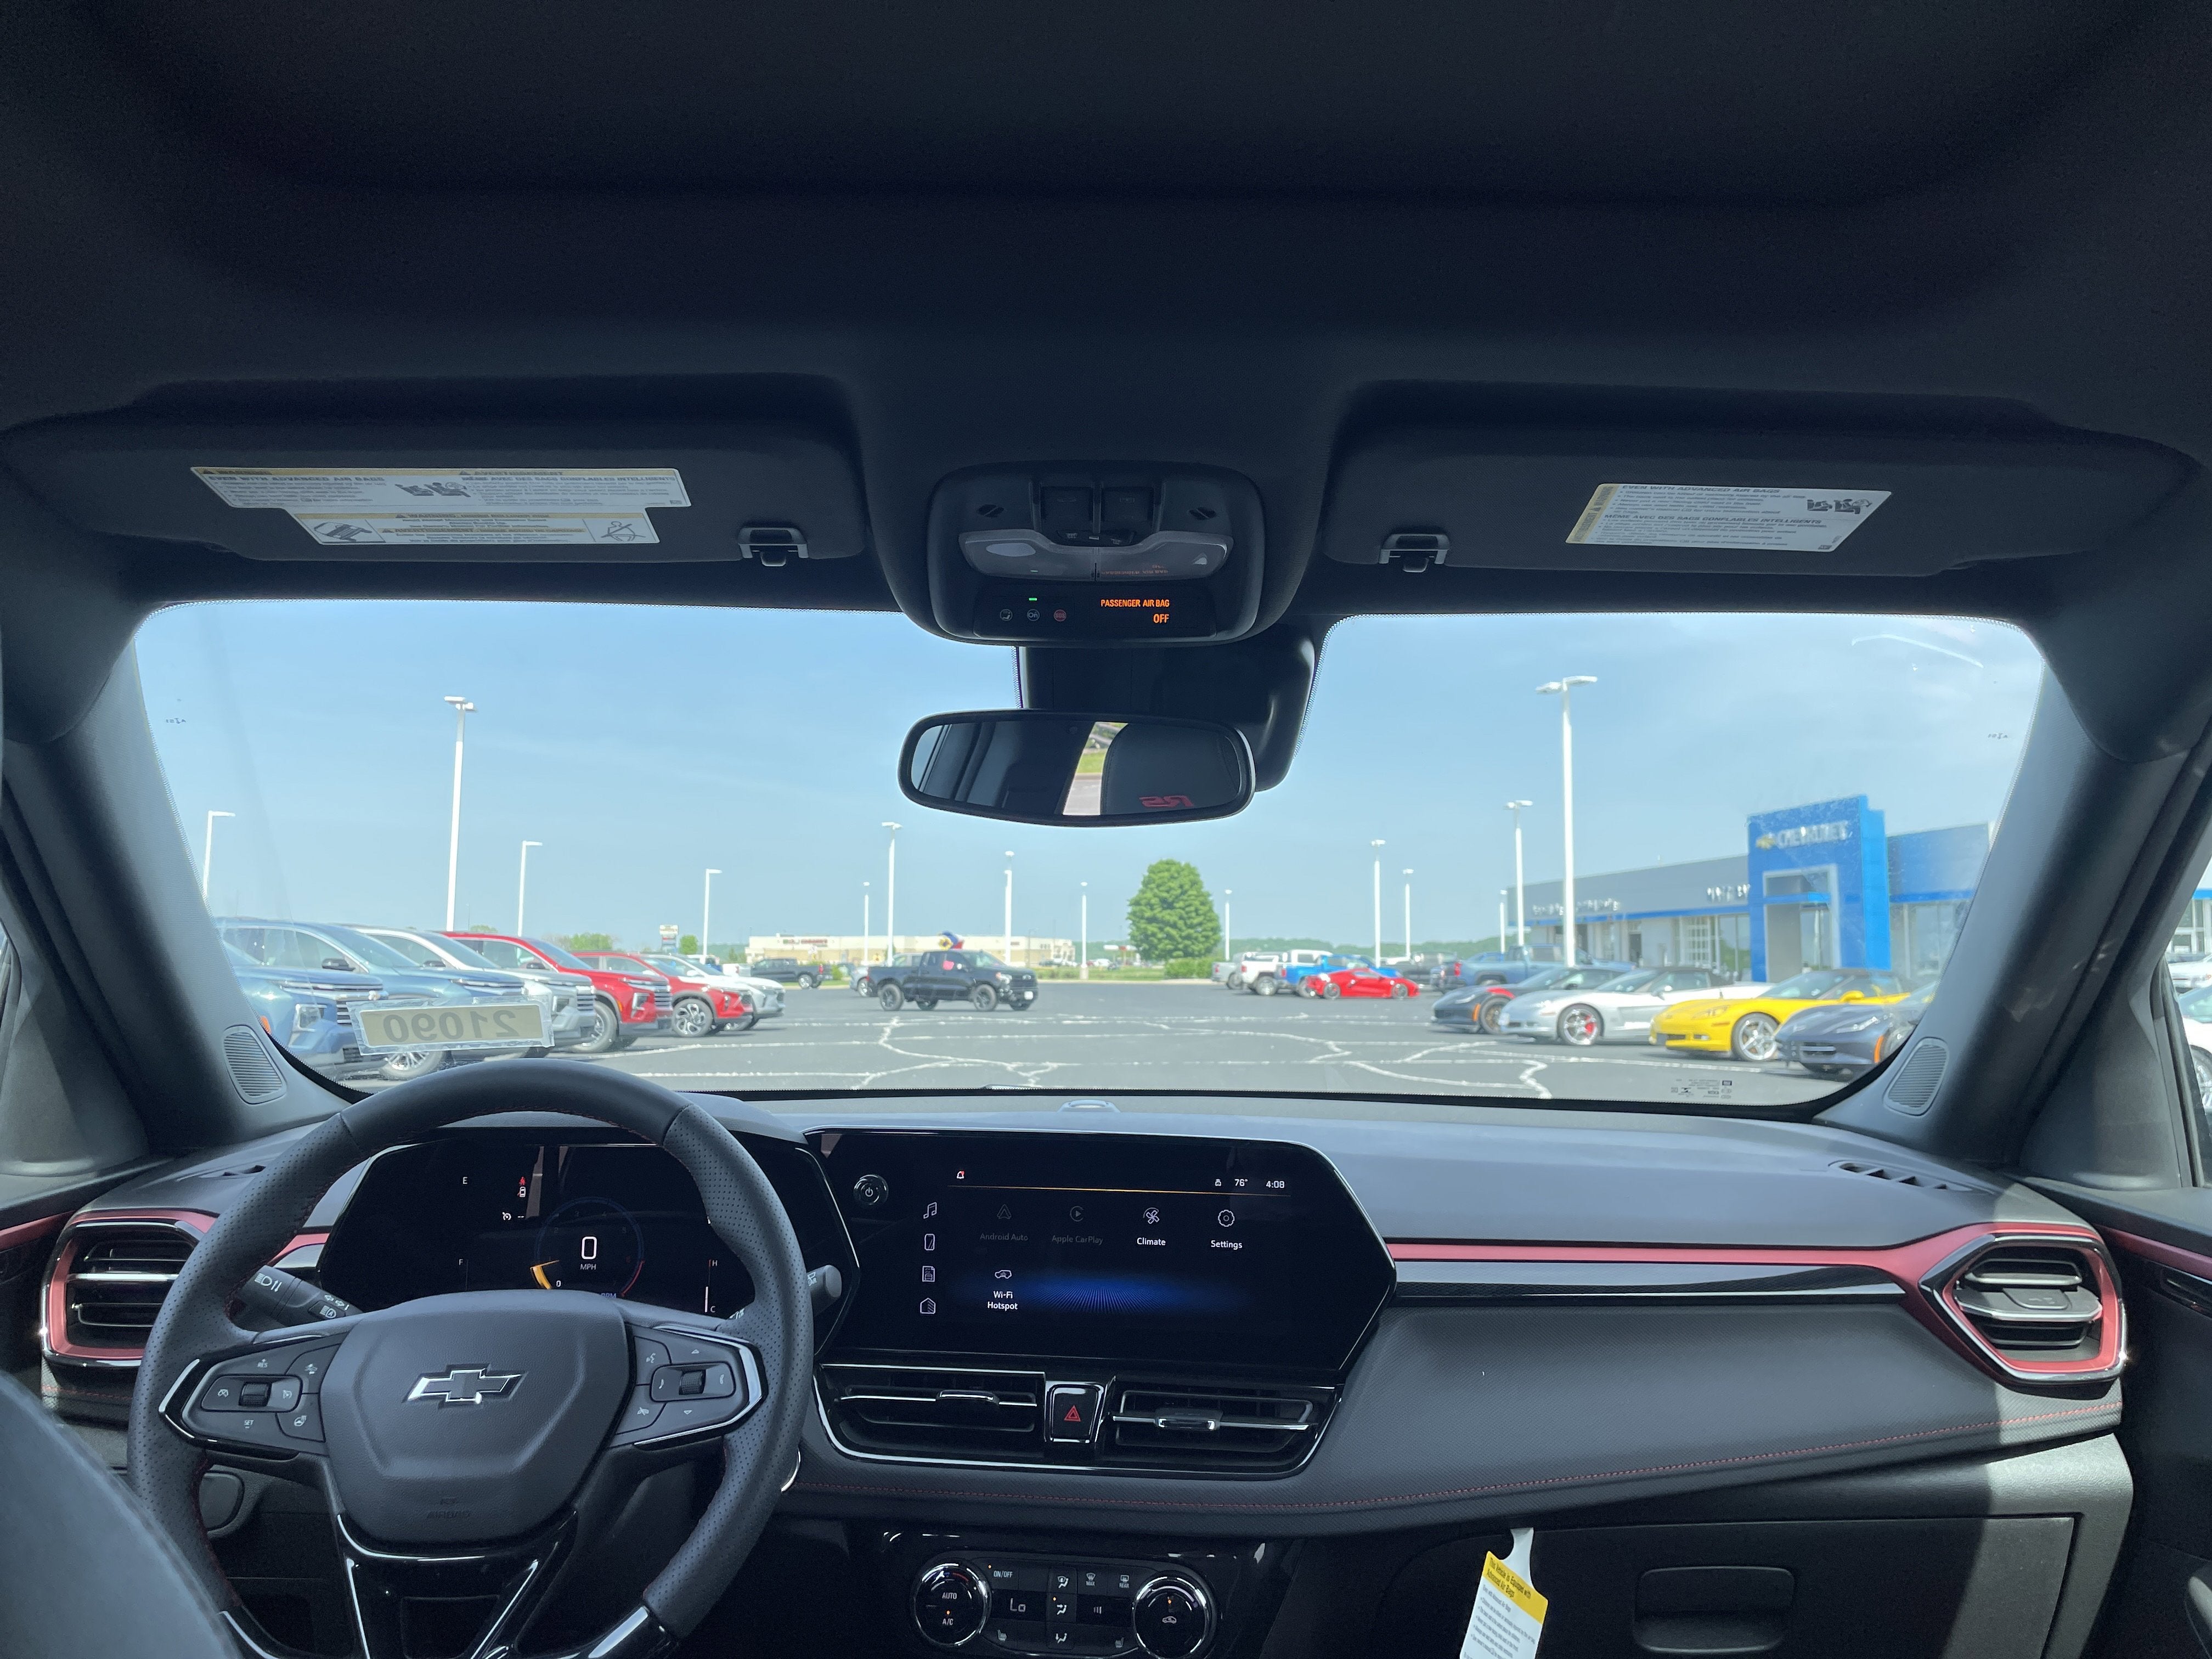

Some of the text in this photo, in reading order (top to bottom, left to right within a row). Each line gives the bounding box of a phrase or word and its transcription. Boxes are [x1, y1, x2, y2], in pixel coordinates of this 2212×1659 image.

[1101, 599, 1141, 607] PASSENGER
[1153, 613, 1170, 624] OFF
[462, 1176, 468, 1184] E
[1266, 1180, 1285, 1189] 4:08
[980, 1233, 1029, 1242] Android Auto
[1051, 1234, 1104, 1246] Apple CarPlay
[1136, 1237, 1166, 1246] Climate
[582, 1236, 597, 1260] 0
[1210, 1239, 1243, 1251] Settings
[993, 1290, 1013, 1299] Wi-Fi
[987, 1301, 1019, 1312] Hotspot
[993, 1570, 1014, 1578] ON/OFF
[941, 1592, 958, 1600] AUTO
[1010, 1597, 1026, 1613] Lo
[942, 1618, 954, 1626] A/C
